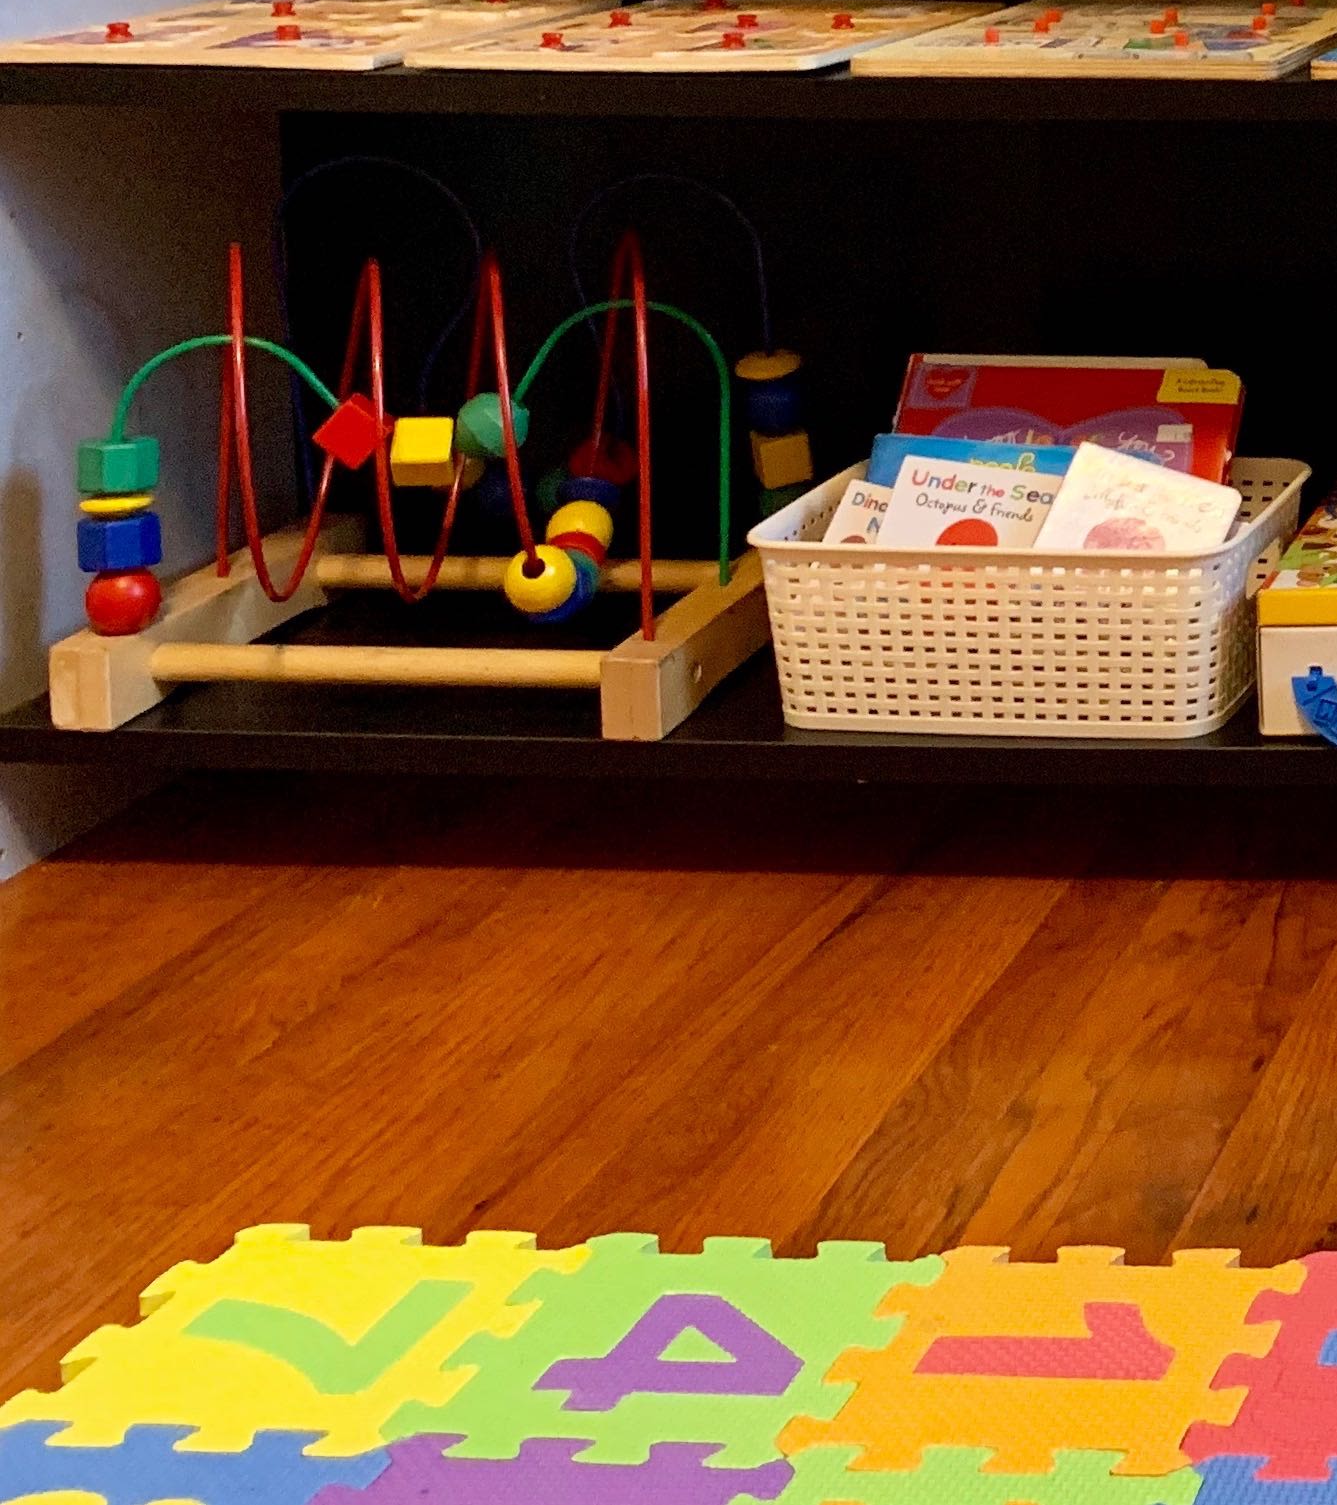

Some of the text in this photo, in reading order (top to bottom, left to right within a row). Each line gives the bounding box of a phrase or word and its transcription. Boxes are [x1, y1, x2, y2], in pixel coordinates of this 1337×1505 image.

[911, 469, 1055, 505] Under the Sea
[915, 492, 967, 514] Octopus
[972, 498, 988, 514] &
[531, 1293, 806, 1412] 4
